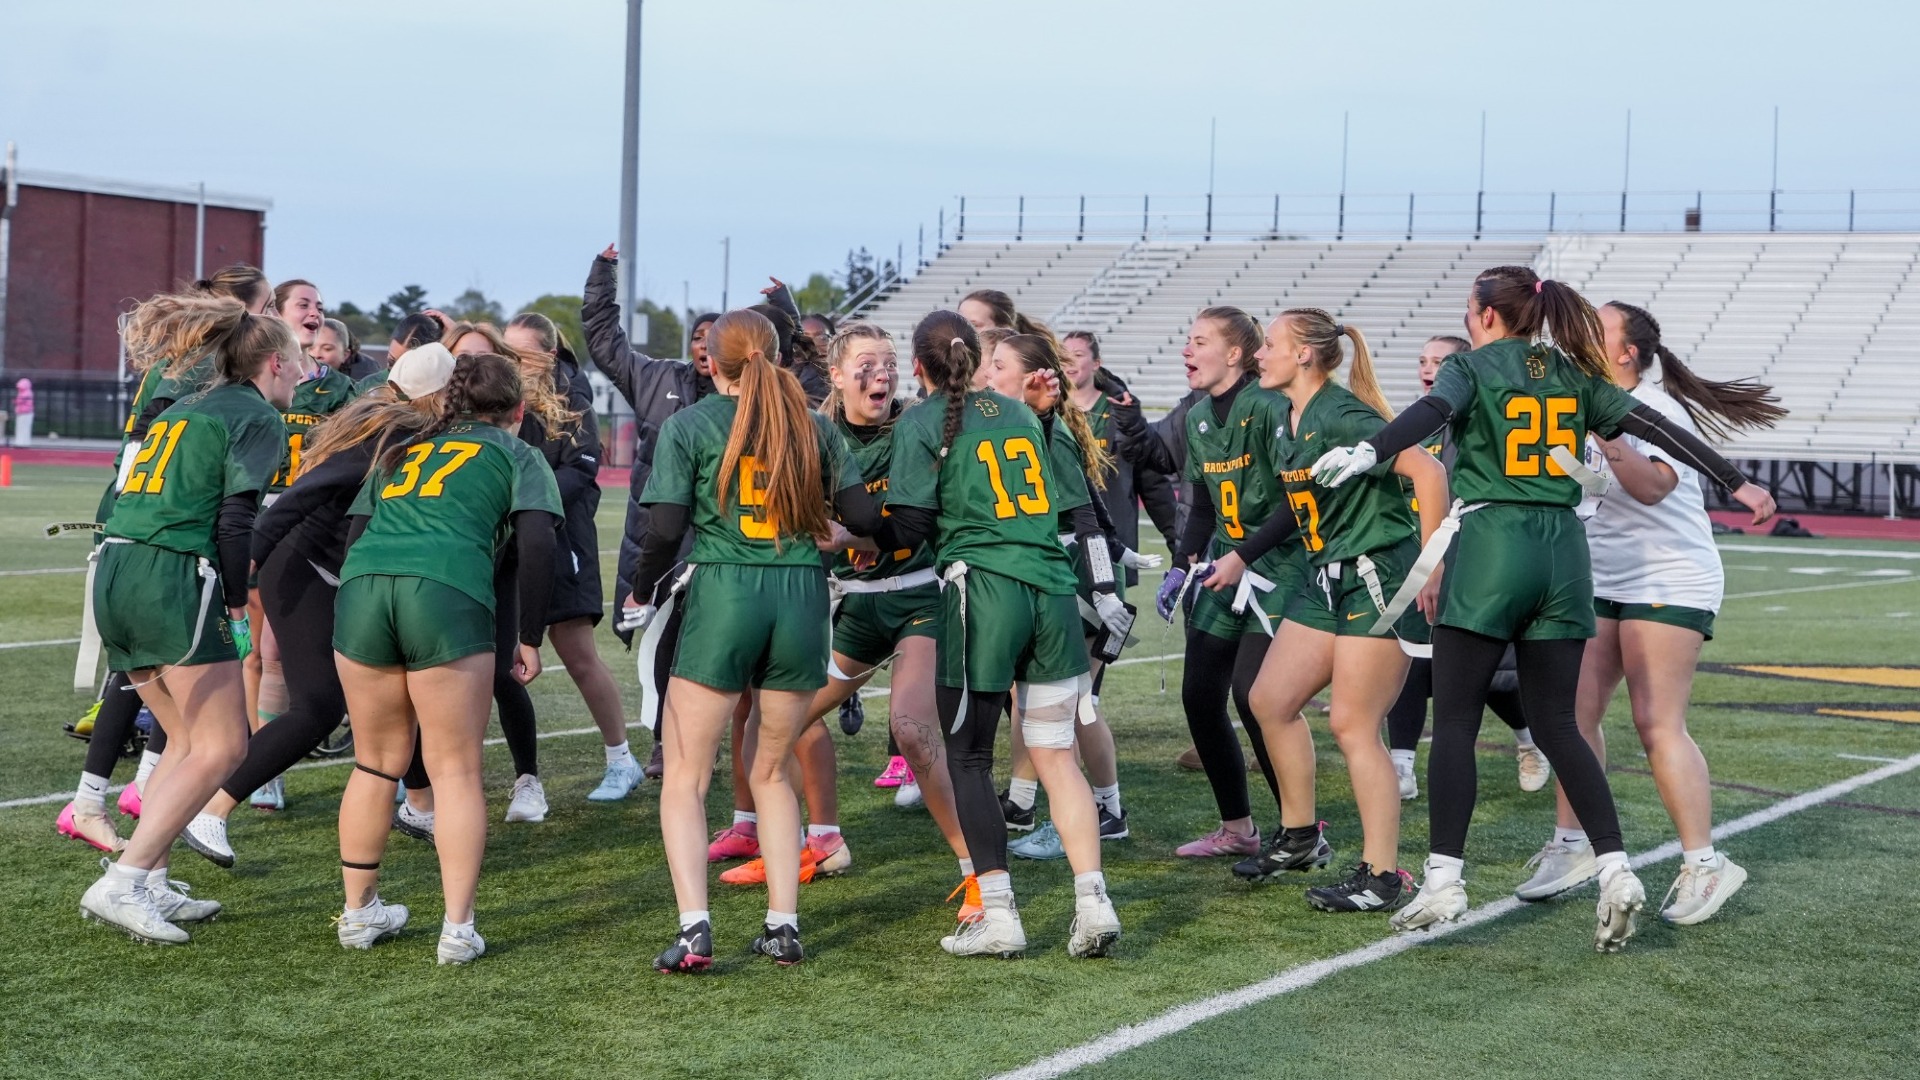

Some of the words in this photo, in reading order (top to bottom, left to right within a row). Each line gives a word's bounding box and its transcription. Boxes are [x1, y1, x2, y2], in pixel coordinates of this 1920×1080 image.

[120, 418, 190, 496] 21
[380, 440, 483, 500] 37
[1505, 396, 1577, 477] 25
[738, 454, 780, 540] 5
[975, 436, 1051, 520] 13
[1219, 479, 1245, 540] 9
[1701, 875, 1720, 901] HOKA
